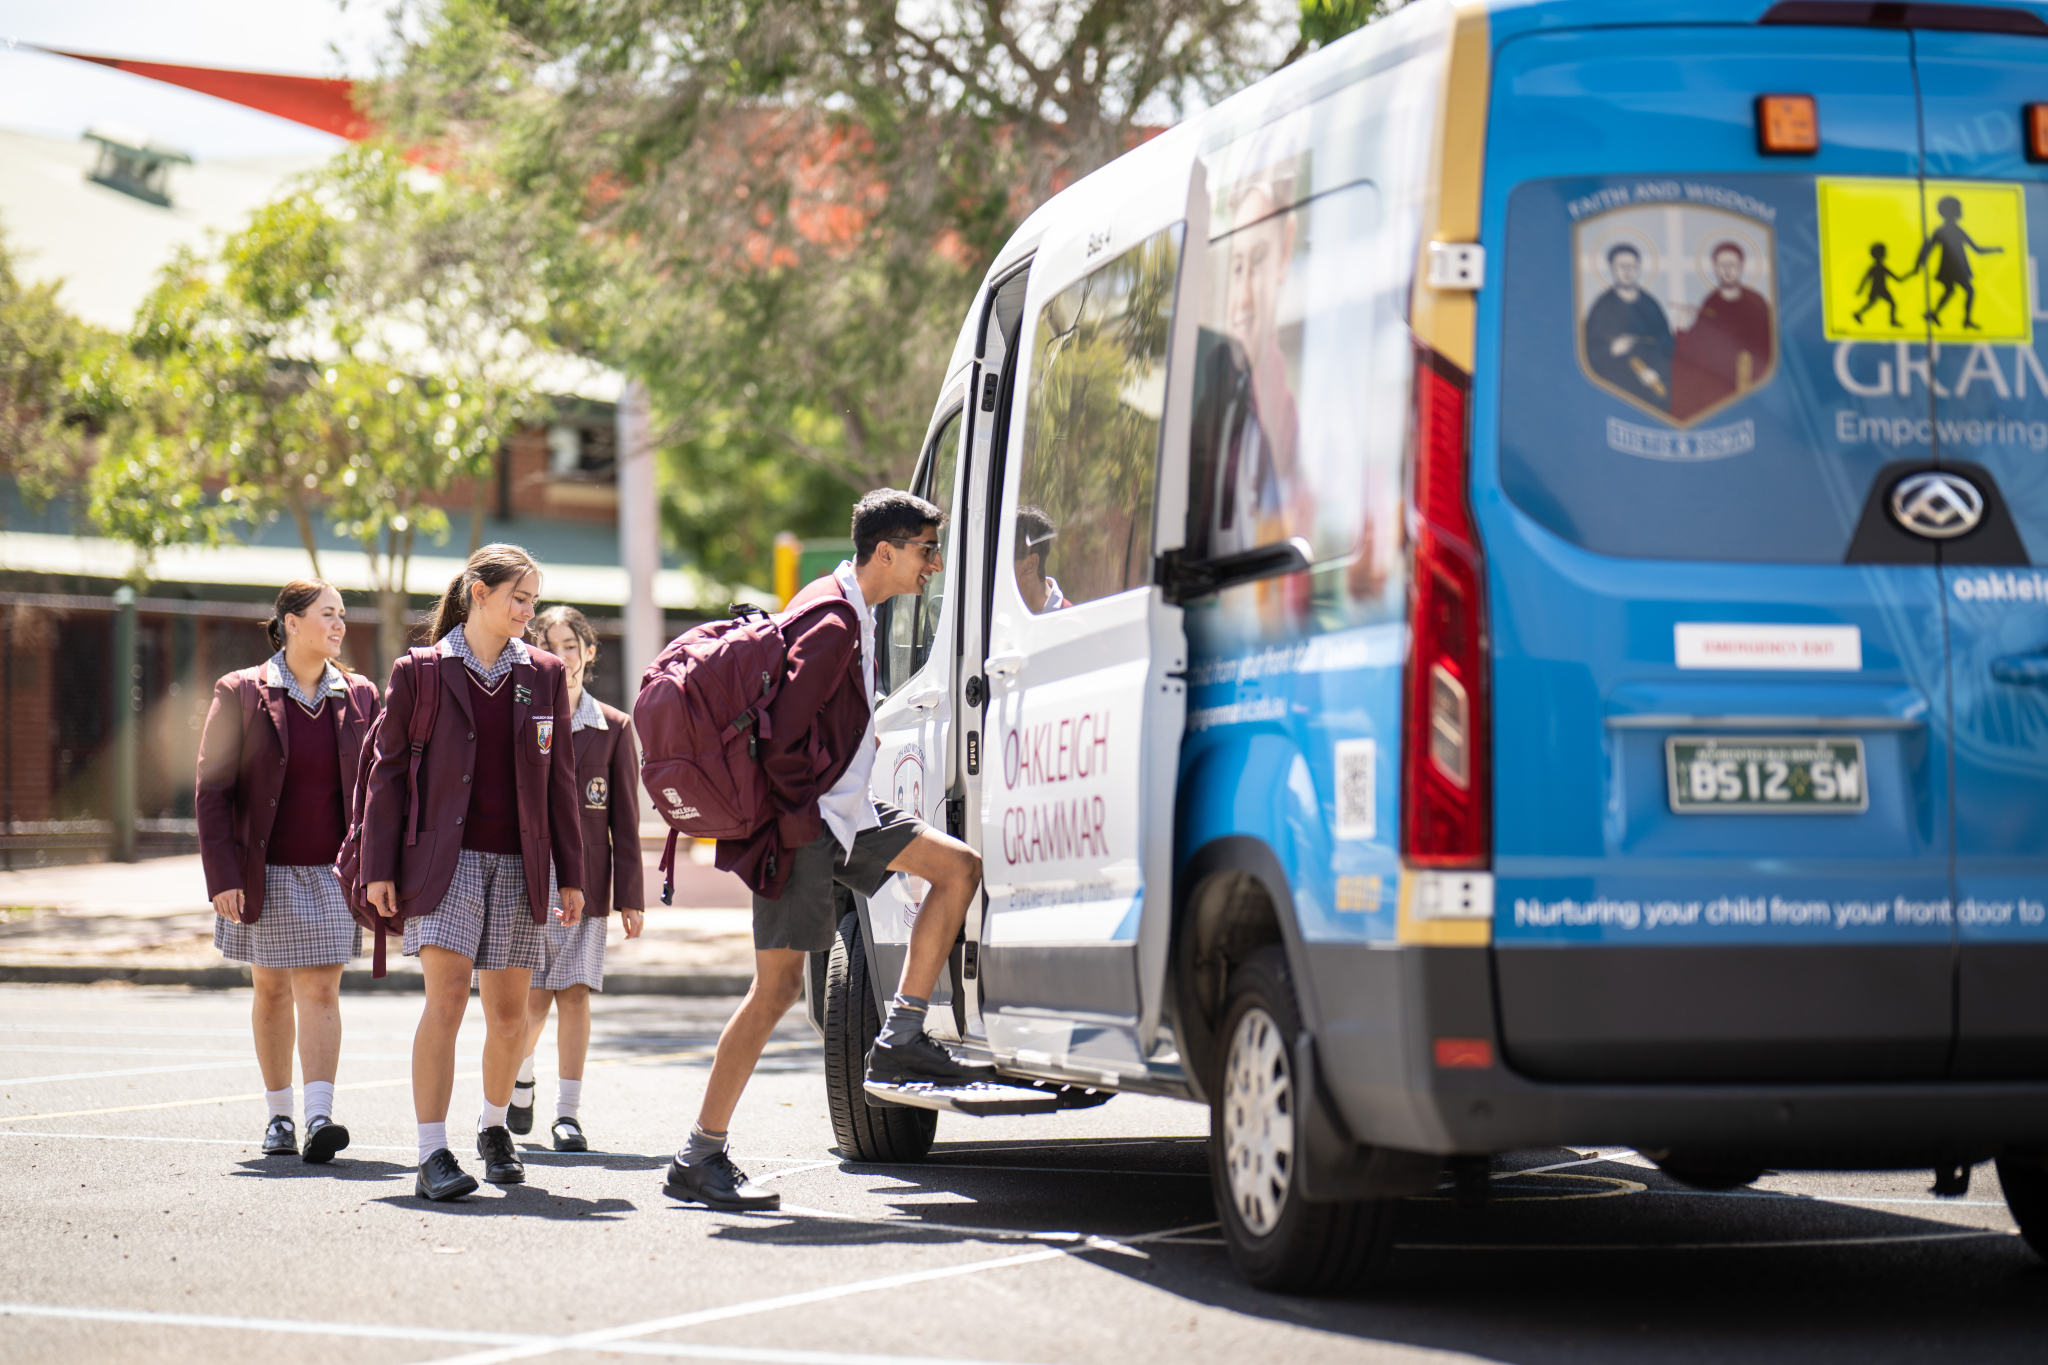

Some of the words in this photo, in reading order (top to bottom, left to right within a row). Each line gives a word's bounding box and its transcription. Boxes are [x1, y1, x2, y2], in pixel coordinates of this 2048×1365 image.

[1567, 185, 1630, 220] FAITH
[1633, 181, 1681, 200] AND
[1683, 181, 1777, 223] WISDOM
[1835, 411, 2048, 452] Empowering
[1702, 640, 1798, 655] EMERGENCY
[1801, 641, 1835, 656] EXIT
[1004, 710, 1110, 790] OAKLEIGH
[1690, 761, 1790, 801] BS12
[1003, 795, 1110, 865] GRAMMAR
[1514, 897, 1641, 930] Nurturing
[1643, 901, 1702, 930] your
[1704, 895, 1767, 926] child
[1770, 895, 1831, 926] from
[1833, 901, 1890, 930] your
[1893, 895, 1954, 926] front
[1956, 896, 2015, 926] door
[2018, 896, 2046, 926] to
